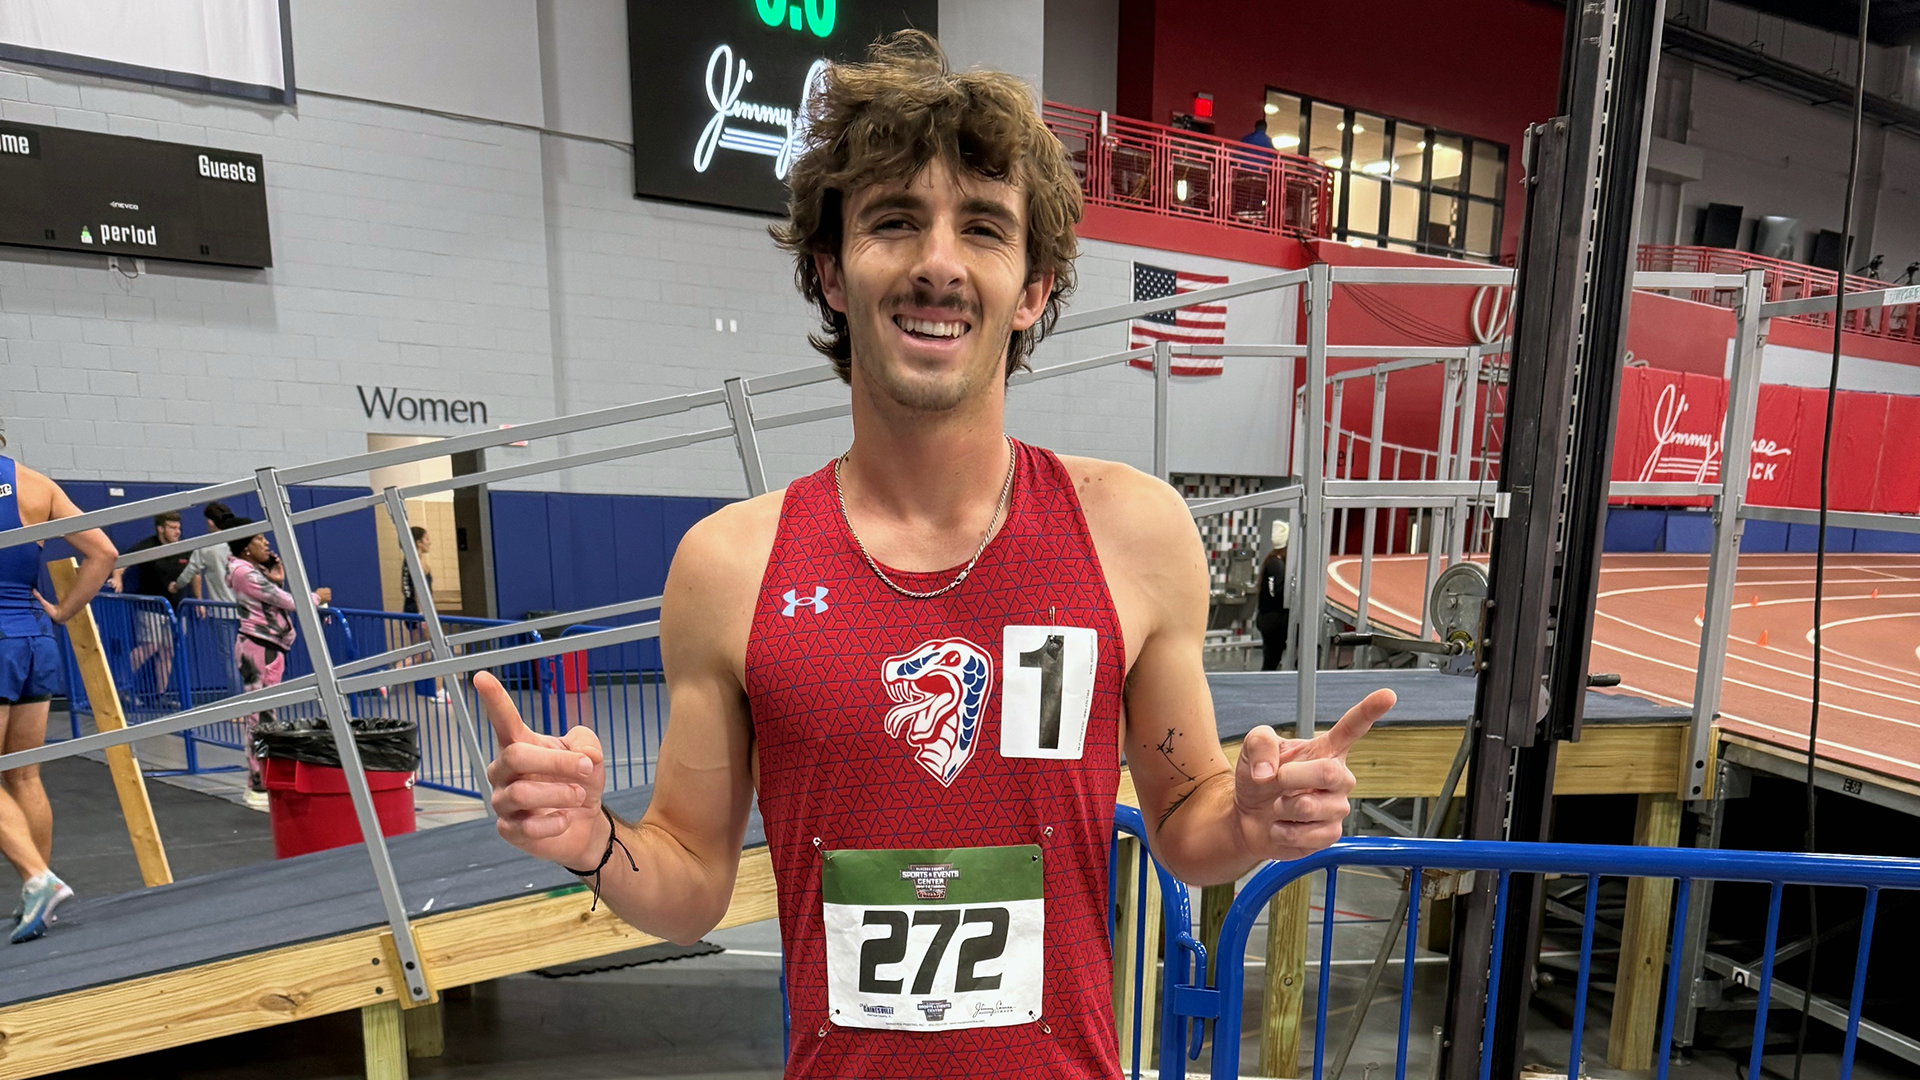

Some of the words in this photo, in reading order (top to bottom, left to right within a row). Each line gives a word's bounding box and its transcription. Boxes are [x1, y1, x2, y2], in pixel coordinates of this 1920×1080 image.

[0, 133, 30, 155] me
[198, 154, 257, 183] Guests
[100, 223, 157, 246] period
[356, 385, 488, 424] Women
[1019, 635, 1064, 749] 1
[859, 907, 1010, 995] 272
